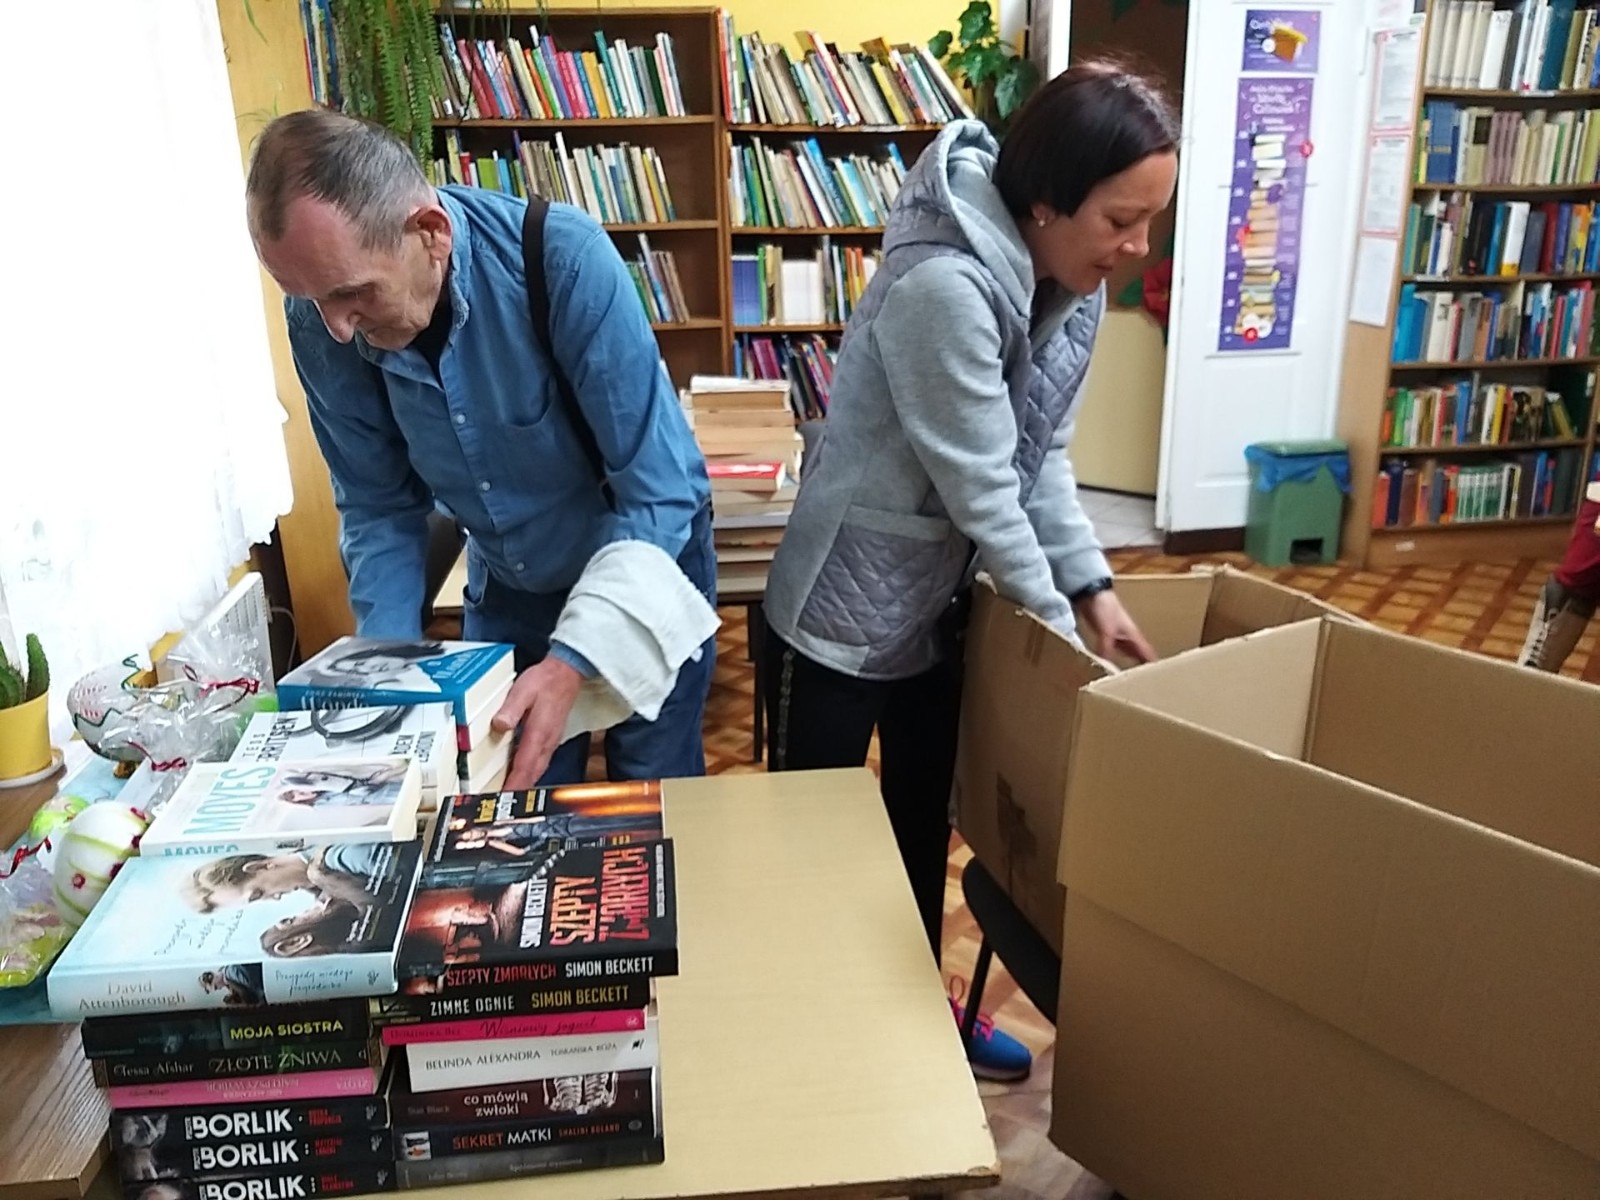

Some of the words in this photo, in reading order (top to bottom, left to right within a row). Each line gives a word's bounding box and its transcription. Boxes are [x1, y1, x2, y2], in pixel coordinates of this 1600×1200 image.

[182, 767, 277, 835] MOYES
[598, 846, 650, 942] ZMARŁYCH
[548, 875, 597, 946] SZEPTY
[447, 968, 491, 986] SZEPTY
[565, 960, 602, 978] SIMON
[605, 956, 654, 975] BECKETT
[107, 980, 153, 996] David
[430, 999, 471, 1016] ZIMNE
[476, 995, 515, 1012] OGNIE
[531, 990, 572, 1009] SIMON
[575, 985, 630, 1005] BECKETT
[78, 992, 187, 1012] Attenborough
[230, 1026, 273, 1040] MOJA
[277, 1020, 344, 1036] SIOSTRA
[113, 1061, 150, 1078] Tessa
[152, 1060, 195, 1076] Afshar
[208, 1056, 274, 1074] ZŁOTE
[278, 1050, 343, 1071] ŻNIWA
[425, 1056, 472, 1071] BELINDA
[477, 1050, 541, 1066] ALEXANDRA
[464, 1095, 482, 1105] co
[484, 1090, 529, 1105] mówią
[475, 1102, 519, 1117] zwłoki
[192, 1108, 293, 1139] BORLIK
[453, 1133, 504, 1149] SEKRET
[507, 1128, 551, 1145] MATKI
[200, 1139, 300, 1170] BORLIK
[207, 1175, 306, 1200] BORLIK
